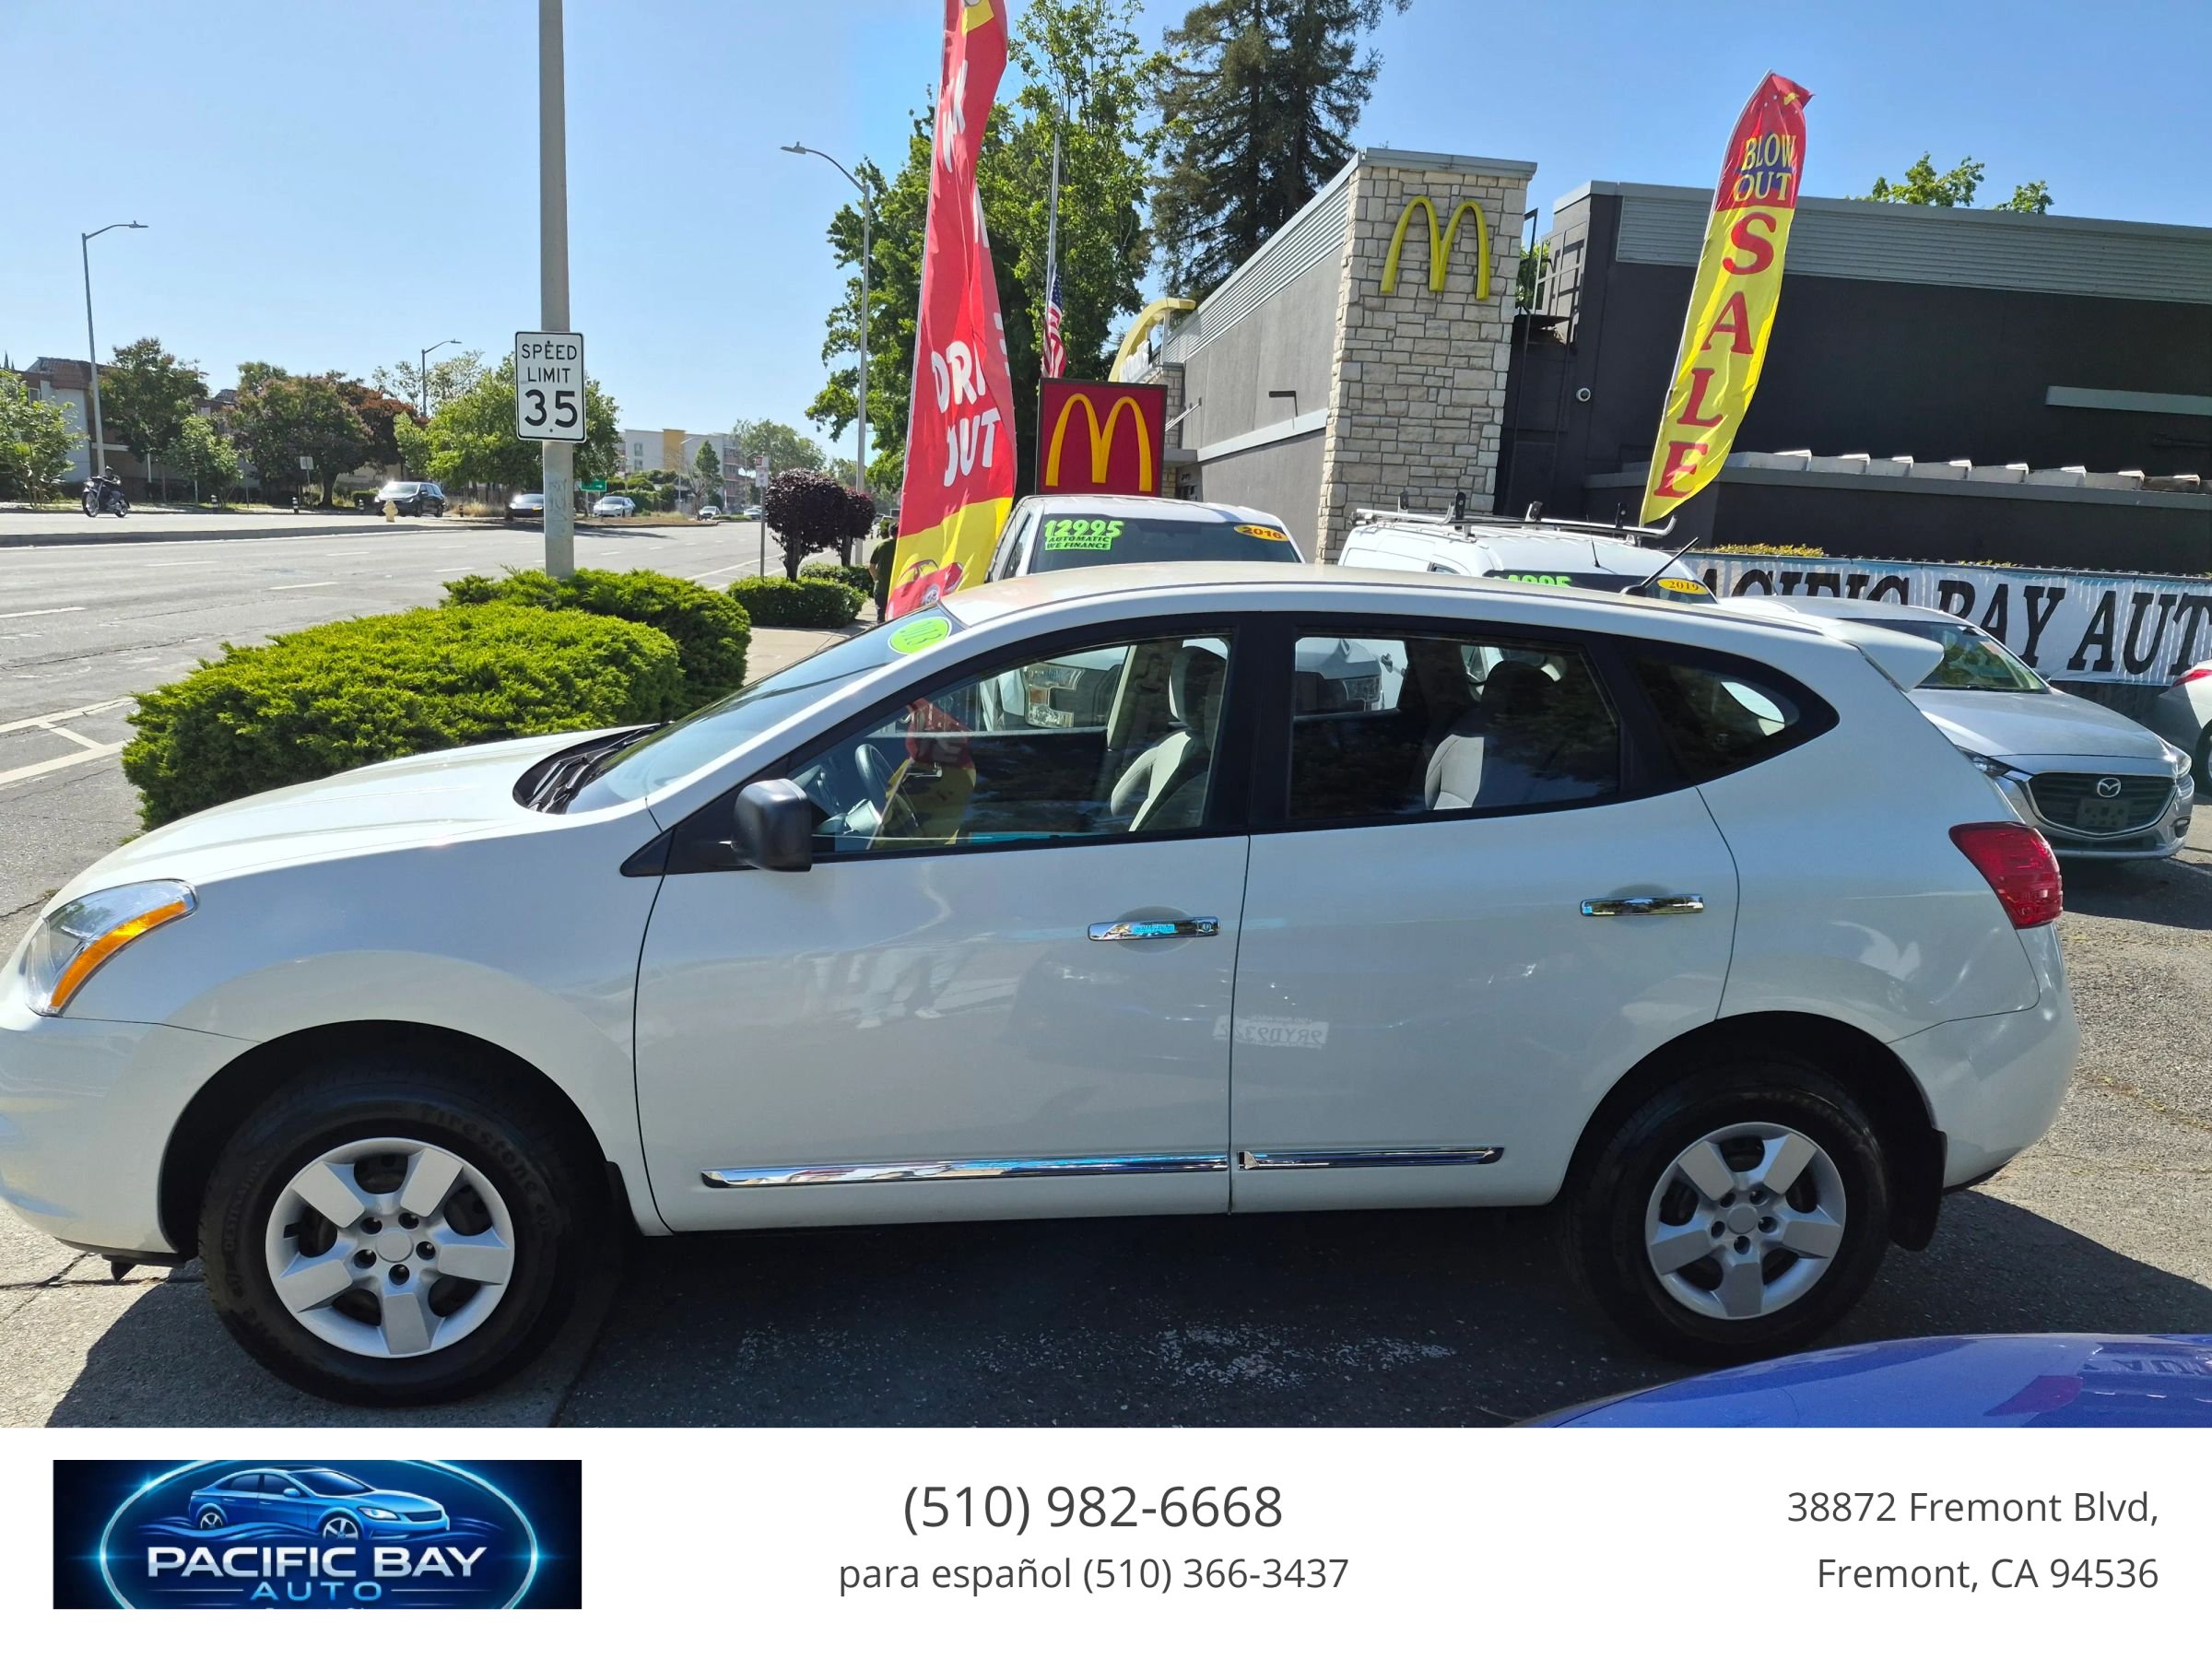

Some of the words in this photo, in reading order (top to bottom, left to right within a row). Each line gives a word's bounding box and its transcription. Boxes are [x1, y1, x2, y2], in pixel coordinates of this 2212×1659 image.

[1741, 133, 1796, 171] BLOW
[1733, 171, 1793, 202] OUT
[522, 344, 578, 360] SPEED
[1653, 212, 1777, 499] SALE
[527, 368, 571, 383] LIMIT
[524, 389, 578, 429] 35
[1044, 519, 1124, 537] 12995
[1242, 526, 1283, 539] 2016
[1669, 581, 1699, 591] 2019
